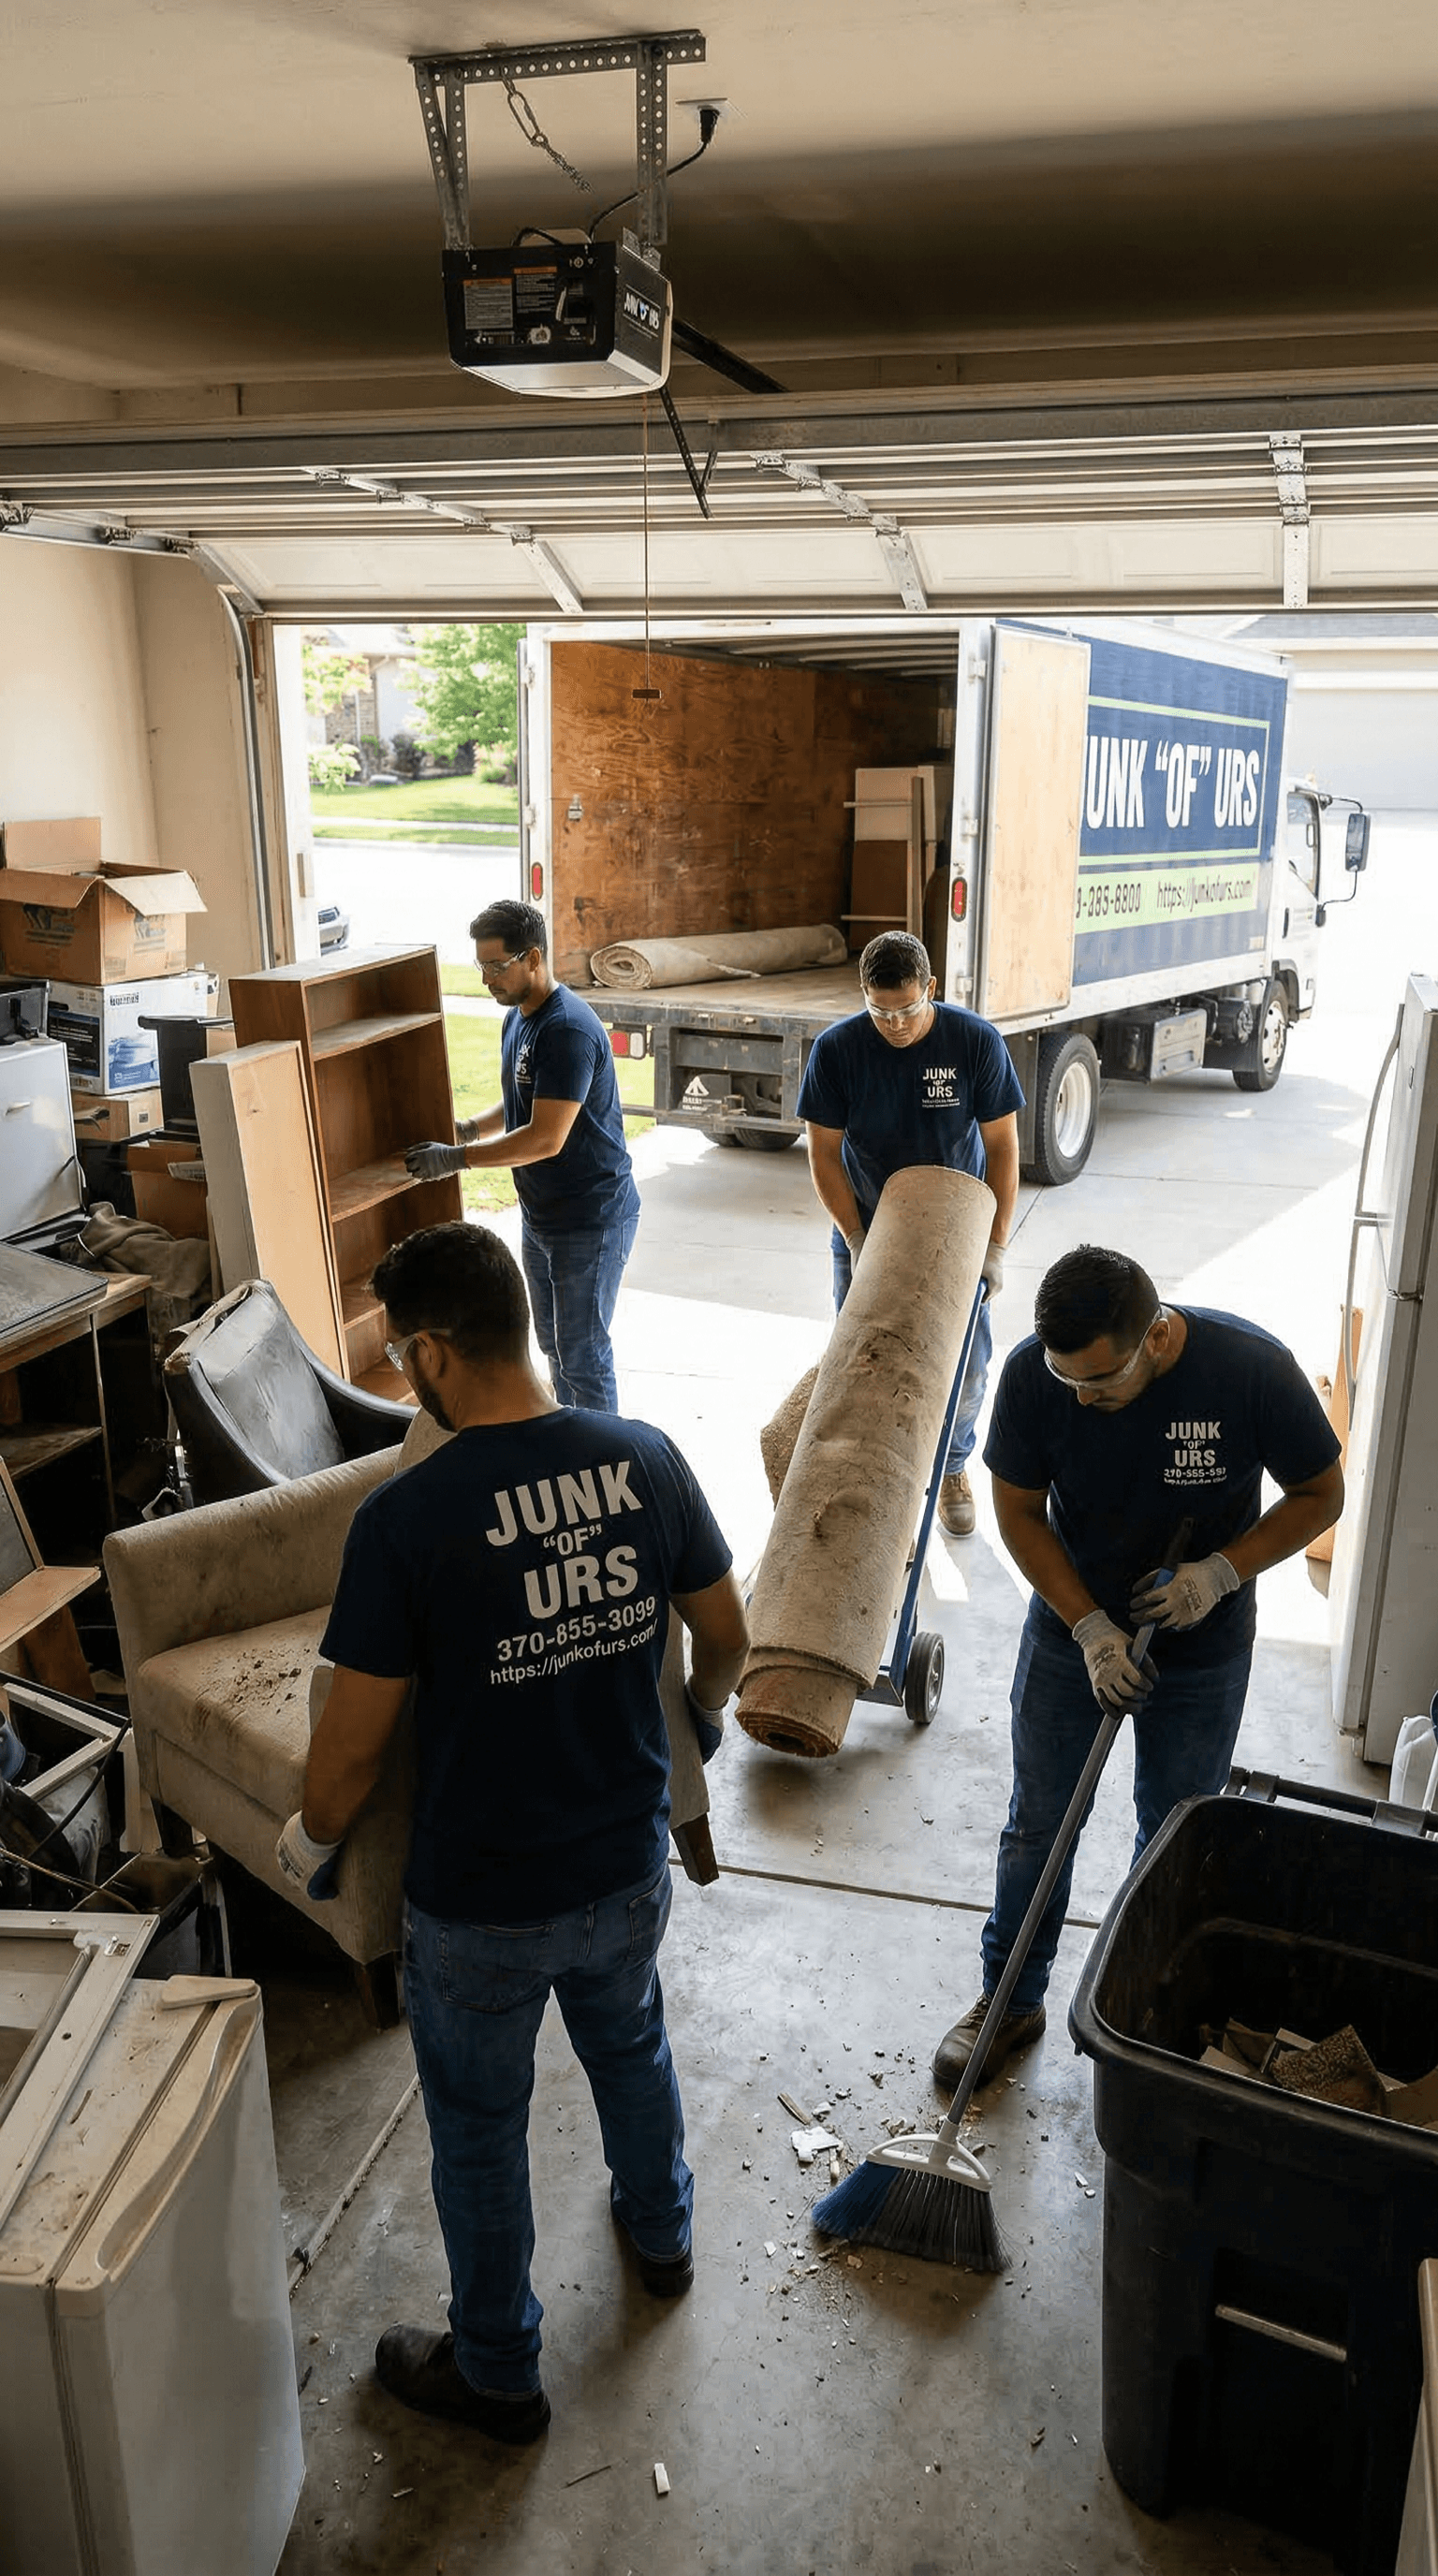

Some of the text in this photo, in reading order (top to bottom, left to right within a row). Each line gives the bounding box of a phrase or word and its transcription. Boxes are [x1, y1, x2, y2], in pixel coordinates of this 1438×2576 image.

[1084, 735, 1260, 829] UNK “OF” URS
[923, 1068, 957, 1080] JUNK
[928, 1086, 952, 1098] URS
[1166, 1422, 1221, 1440] JUNK
[1175, 1450, 1215, 1467] URS
[486, 1460, 643, 1546] JUNK
[543, 1524, 602, 1556] “OF”
[524, 1545, 638, 1619] URS
[491, 1617, 658, 1685] https://junkofurs.com/
[497, 1596, 655, 1661] 370-855-3099
